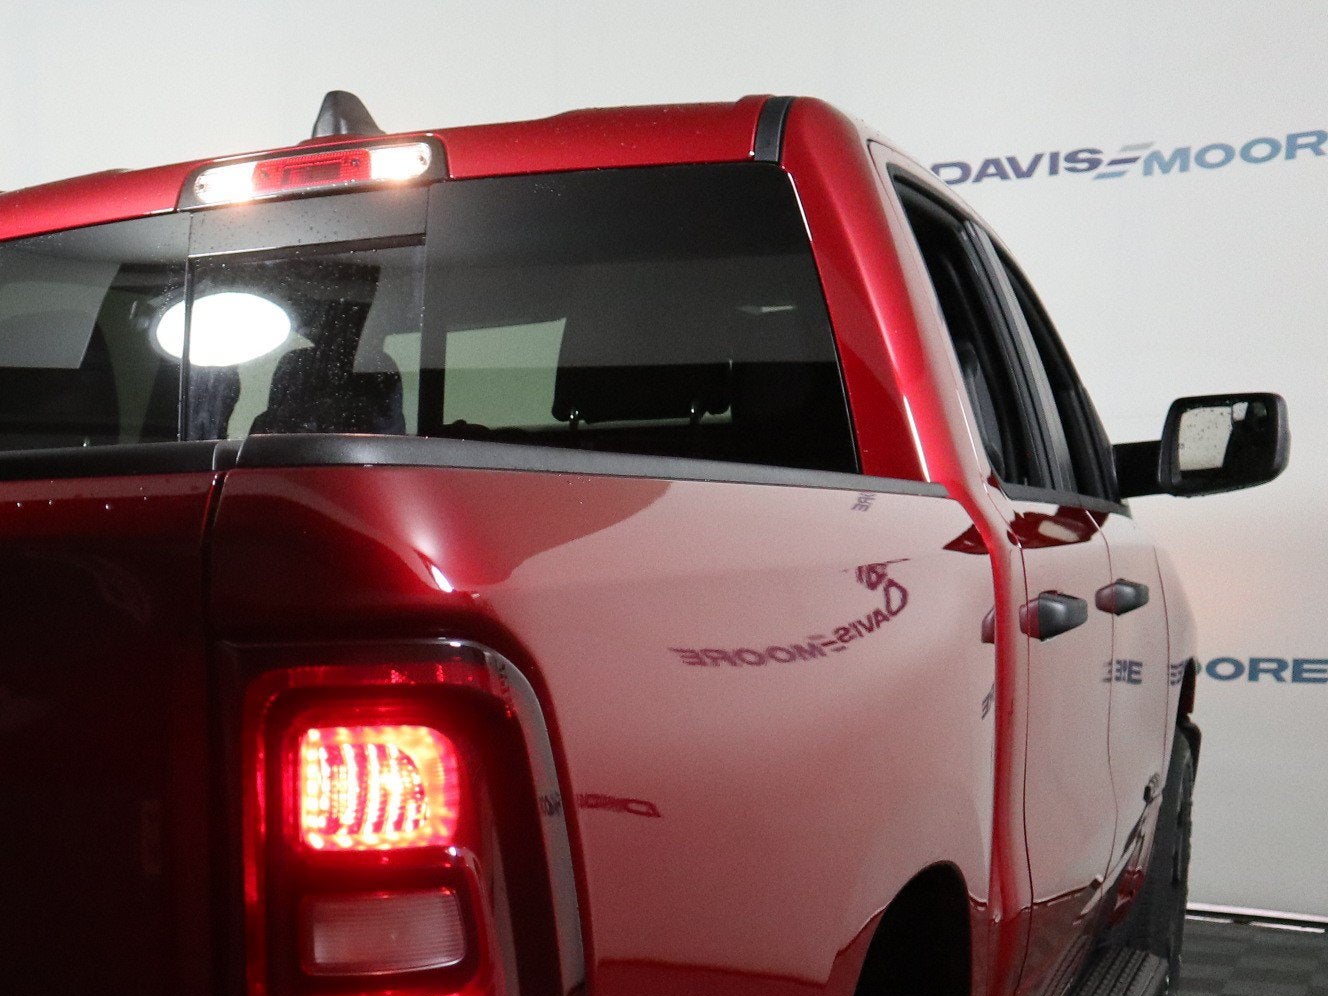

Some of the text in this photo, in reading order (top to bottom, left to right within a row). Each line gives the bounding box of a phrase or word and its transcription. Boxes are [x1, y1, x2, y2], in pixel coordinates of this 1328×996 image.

[930, 129, 1328, 186] DAVIS MOOR
[1196, 656, 1328, 683] ORE
